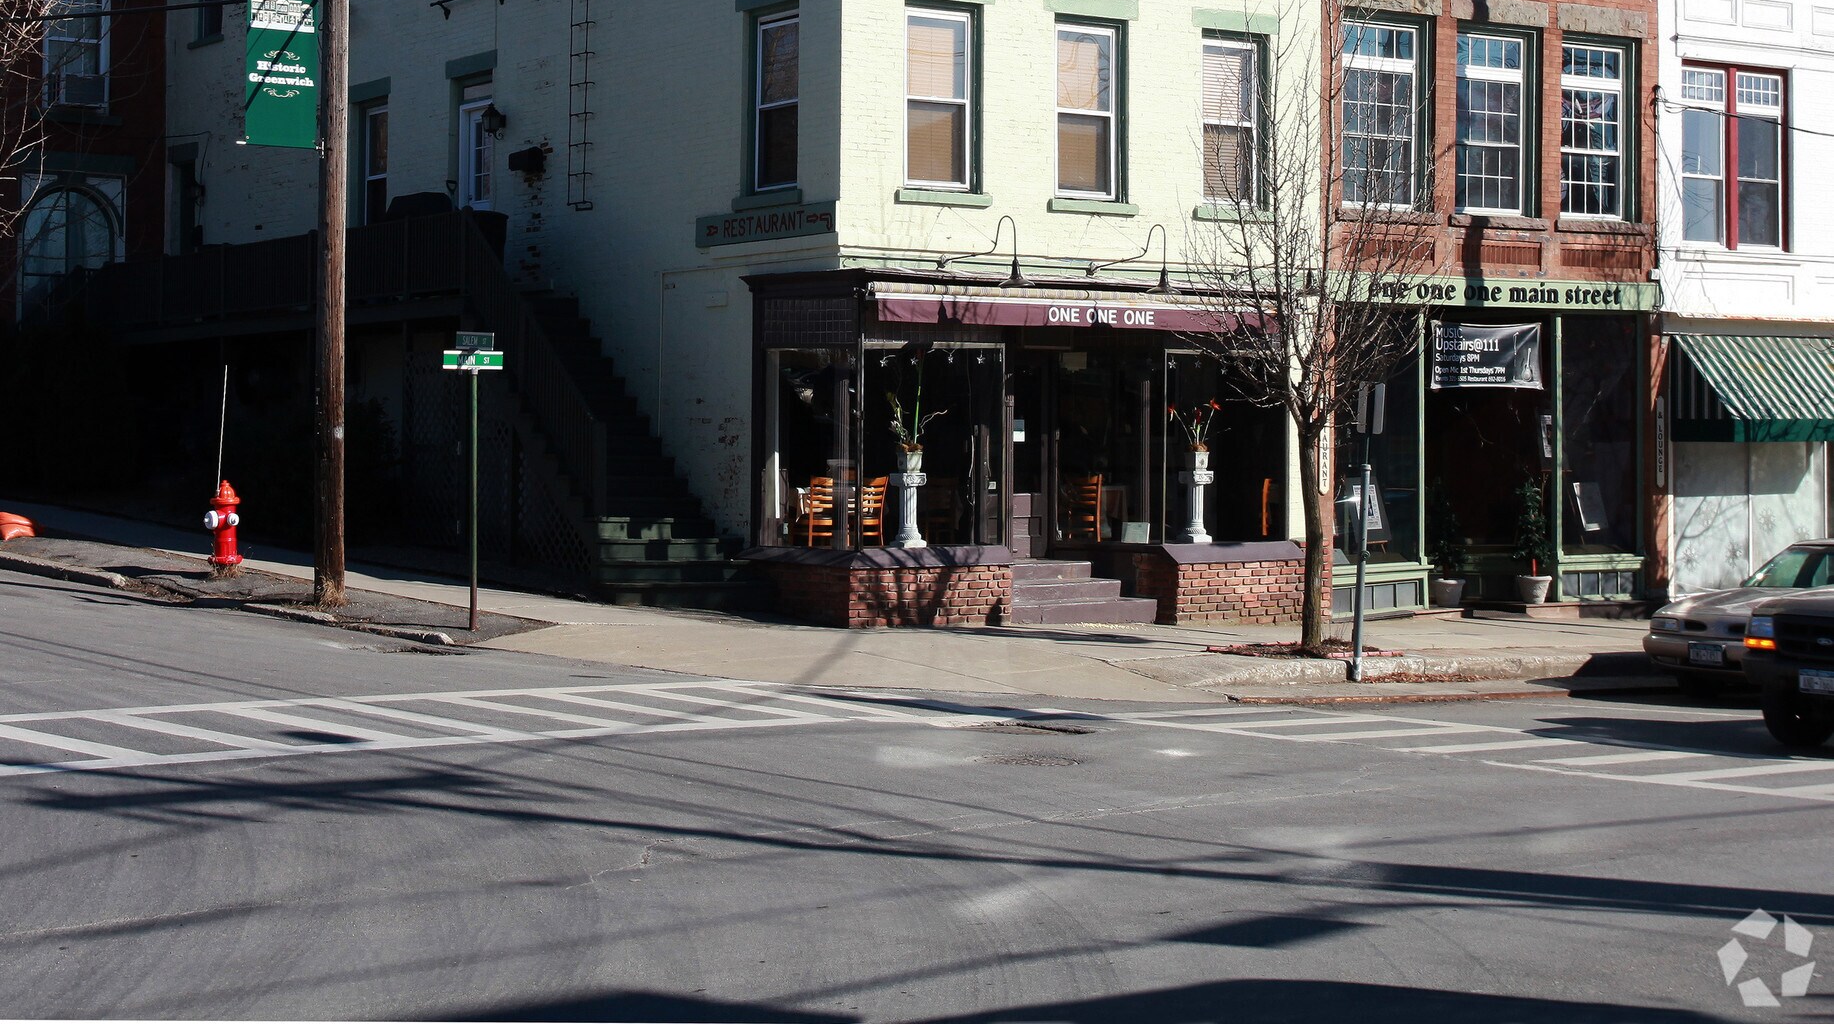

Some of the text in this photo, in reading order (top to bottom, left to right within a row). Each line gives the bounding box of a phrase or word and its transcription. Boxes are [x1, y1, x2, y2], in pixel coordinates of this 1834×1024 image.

[256, 60, 306, 74] Historic
[248, 72, 315, 87] Greenwich
[723, 210, 805, 238] RESTAURANT
[1416, 283, 1457, 300] one
[1463, 284, 1502, 302] one
[1508, 282, 1559, 304] main
[1565, 285, 1622, 305] street
[1048, 306, 1155, 325] ONE ONE ONE
[1436, 328, 1463, 338] MUSIC
[462, 336, 478, 345] SALEM
[1436, 338, 1499, 353] Upstairs@111
[457, 355, 490, 365] MAIN ST
[1435, 353, 1480, 363] Saturdays 8PM
[1435, 366, 1449, 375] Open
[1450, 366, 1459, 374] Mic
[1469, 367, 1494, 375] Thursdays
